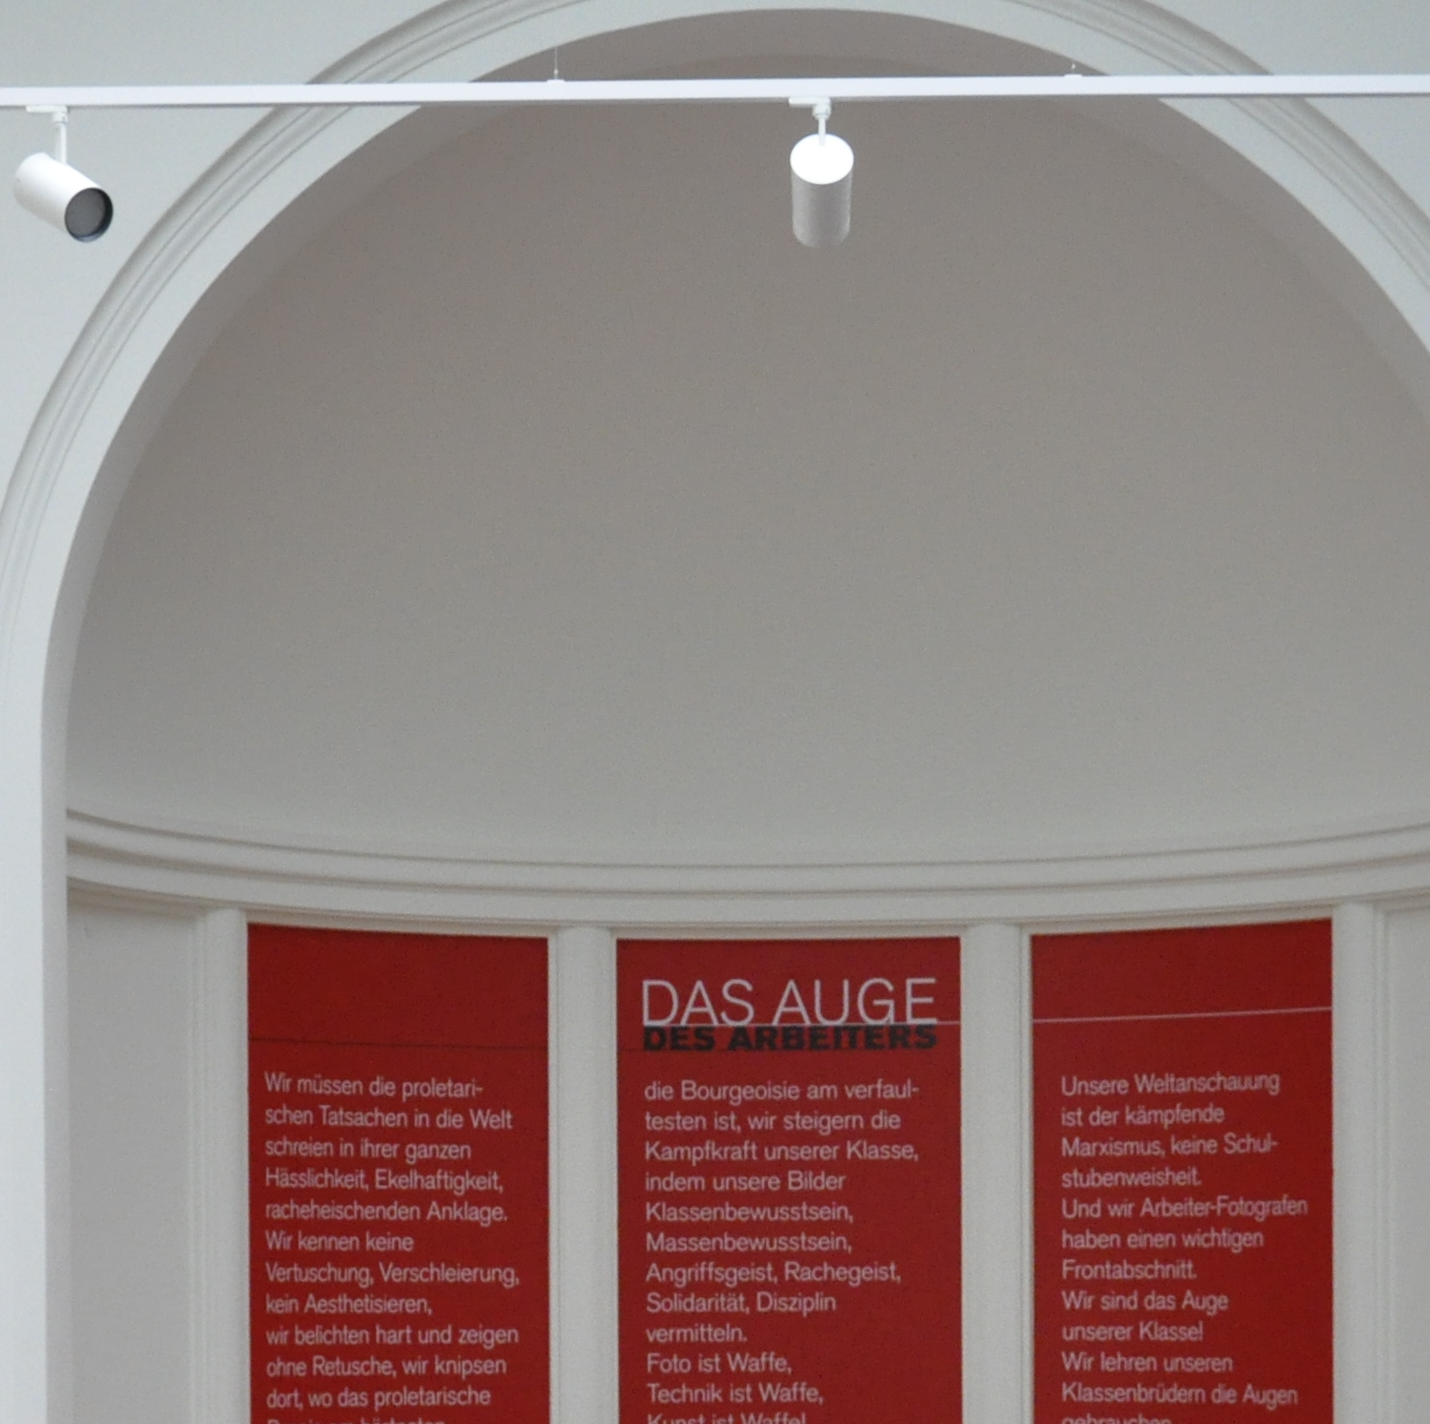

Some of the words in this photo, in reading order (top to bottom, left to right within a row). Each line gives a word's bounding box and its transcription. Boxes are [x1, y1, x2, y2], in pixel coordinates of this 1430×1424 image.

[641, 978, 756, 1027] DAS
[771, 977, 938, 1026] AUGE
[642, 1025, 716, 1051] DES
[726, 1024, 938, 1051] ARBEITERS
[264, 1071, 292, 1092] Wir
[297, 1072, 364, 1096] müssen
[368, 1075, 397, 1097] die
[644, 1080, 675, 1101] die
[680, 1079, 801, 1107] Bourgeoisie
[806, 1084, 839, 1100] am
[844, 1078, 920, 1100] verfaul-
[1061, 1075, 1130, 1097] Unsere
[1134, 1072, 1280, 1096] Weltanschauung
[265, 1104, 314, 1125] schen
[318, 1104, 408, 1128] Tatsachen
[414, 1105, 430, 1128] in
[435, 1108, 464, 1129] die
[469, 1108, 513, 1130] Welt
[644, 1111, 707, 1132] testen
[713, 1111, 742, 1133] ist,
[747, 1110, 778, 1130] wir
[783, 1110, 865, 1137] steigern
[870, 1109, 902, 1130] die
[1061, 1107, 1084, 1128] ist
[1088, 1105, 1120, 1127] der
[1125, 1102, 1225, 1130] kämpfende
[265, 1136, 334, 1157] schreien
[339, 1137, 355, 1157] in
[360, 1137, 400, 1159] ihrer
[405, 1142, 472, 1166] ganzen
[645, 1139, 758, 1167] Kampfkraft
[764, 1144, 840, 1161] unserer
[846, 1139, 919, 1162] Klasse,
[1170, 1135, 1219, 1155] keine
[645, 1171, 706, 1192] indem
[712, 1175, 782, 1192] unsere
[787, 1169, 847, 1192] Bilder
[645, 1201, 854, 1224] Klassenbewusstsein,
[1061, 1198, 1102, 1220] Und
[1107, 1198, 1136, 1218] wir
[1139, 1194, 1308, 1223] Arbeiter-Fotografen
[265, 1230, 293, 1250] Wir
[298, 1230, 360, 1252] kennen
[365, 1231, 415, 1252] keine
[645, 1231, 853, 1254] Massenbewusstsein,
[1061, 1228, 1121, 1250] haben
[1126, 1229, 1177, 1249] einen
[1181, 1227, 1264, 1254] wichtigen
[645, 1261, 779, 1289] Angriffsgeist,
[784, 1260, 902, 1288] Rachegeist,
[266, 1293, 299, 1314] kein
[646, 1291, 750, 1315] Solidarität,
[756, 1290, 837, 1318] Disziplin
[1061, 1289, 1096, 1311] Wir
[1100, 1290, 1139, 1311] sind
[1143, 1290, 1177, 1311] das
[1181, 1289, 1229, 1317] Auge
[266, 1325, 289, 1345] wir
[294, 1324, 370, 1346] belichten
[375, 1324, 412, 1345] hart
[417, 1324, 453, 1345] und
[457, 1326, 519, 1350] zeigen
[645, 1322, 748, 1344] vermitteln.
[1062, 1325, 1134, 1342] unserer
[266, 1355, 308, 1377] ohne
[401, 1355, 429, 1375] wir
[434, 1354, 507, 1381] knipsen
[646, 1352, 692, 1374] Foto
[697, 1353, 721, 1374] ist
[726, 1351, 792, 1375] Waffe,
[1061, 1350, 1095, 1372] Wir
[1100, 1351, 1158, 1373] lehren
[1163, 1356, 1233, 1373] unseren
[307, 1392, 333, 1408] wo
[337, 1387, 369, 1408] das
[374, 1384, 492, 1412] proletarische
[646, 1382, 723, 1404] Technik
[729, 1383, 753, 1403] ist
[758, 1381, 824, 1405] Waffe,
[1211, 1383, 1237, 1404] die
[1242, 1383, 1298, 1411] Augen
